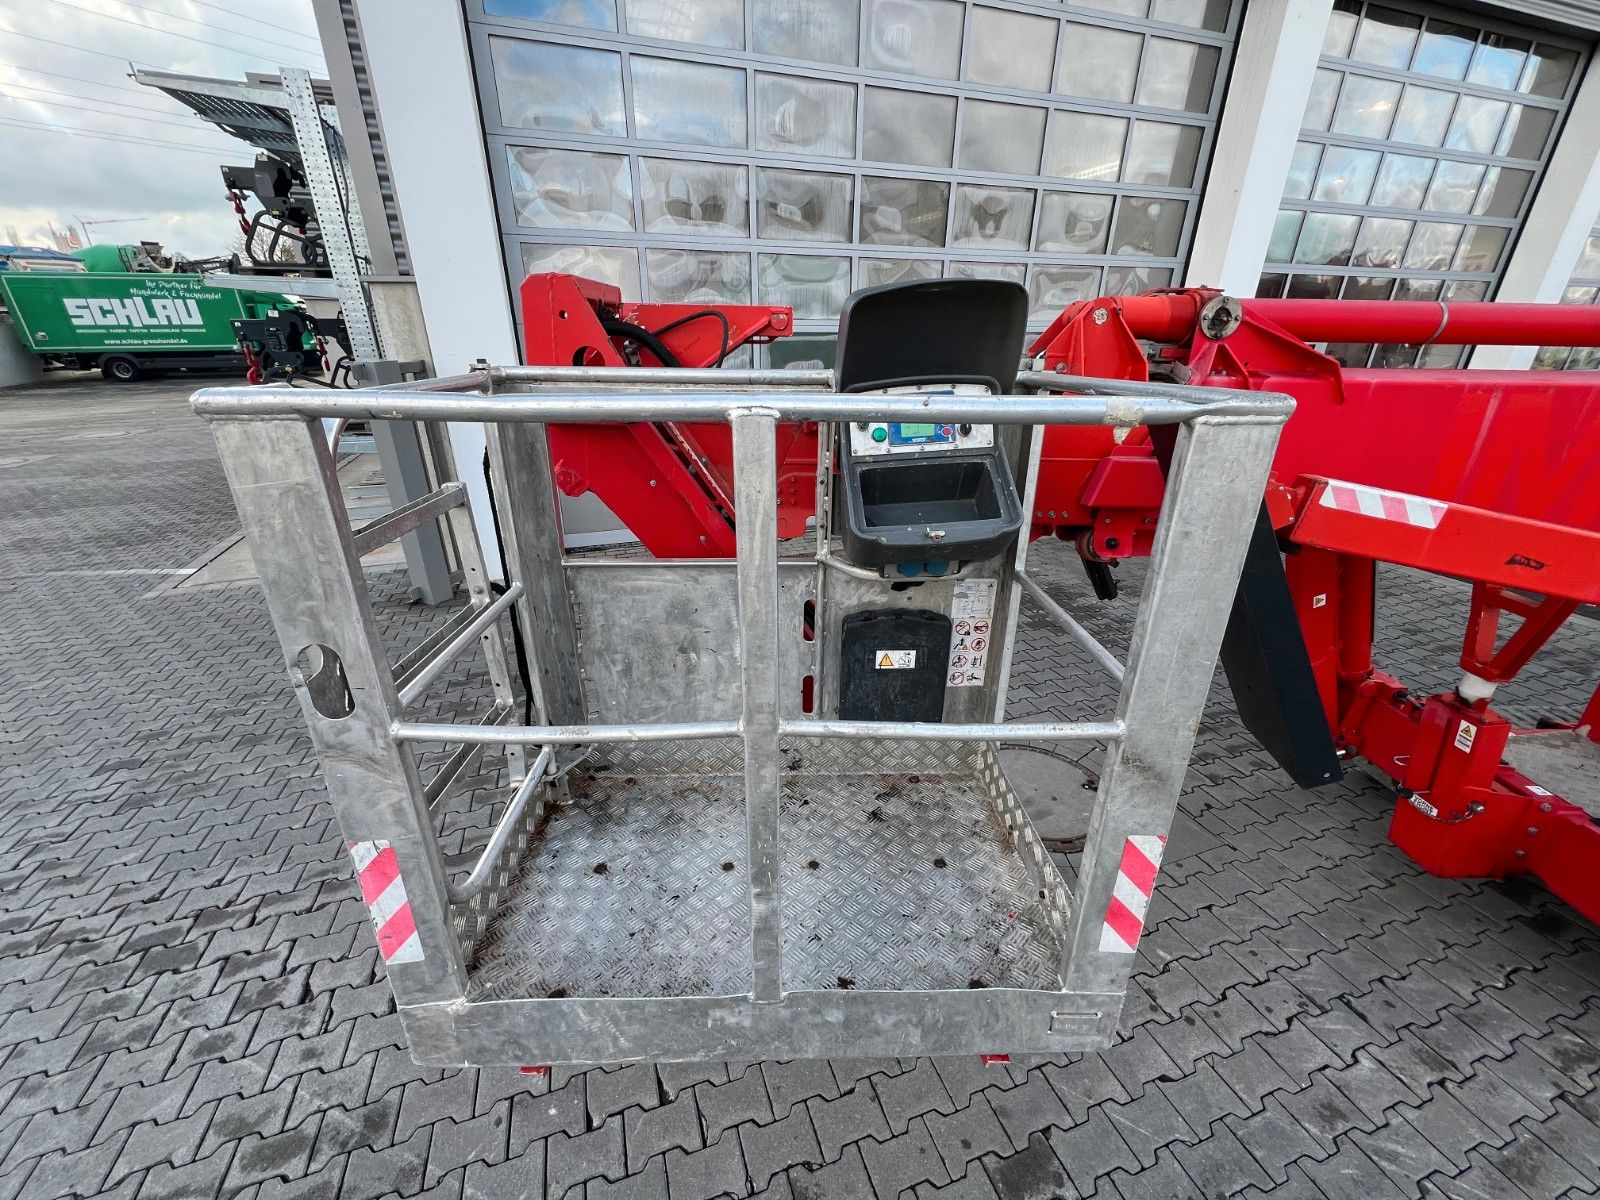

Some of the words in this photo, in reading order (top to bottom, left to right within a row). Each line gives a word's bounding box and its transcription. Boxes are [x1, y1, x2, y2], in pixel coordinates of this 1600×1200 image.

[145, 279, 156, 288] Ihr
[157, 280, 187, 289] Partner
[189, 280, 202, 290] für
[129, 287, 171, 297] Handwerk
[179, 290, 221, 300] Fachhandel
[62, 296, 204, 328] SCHLAU
